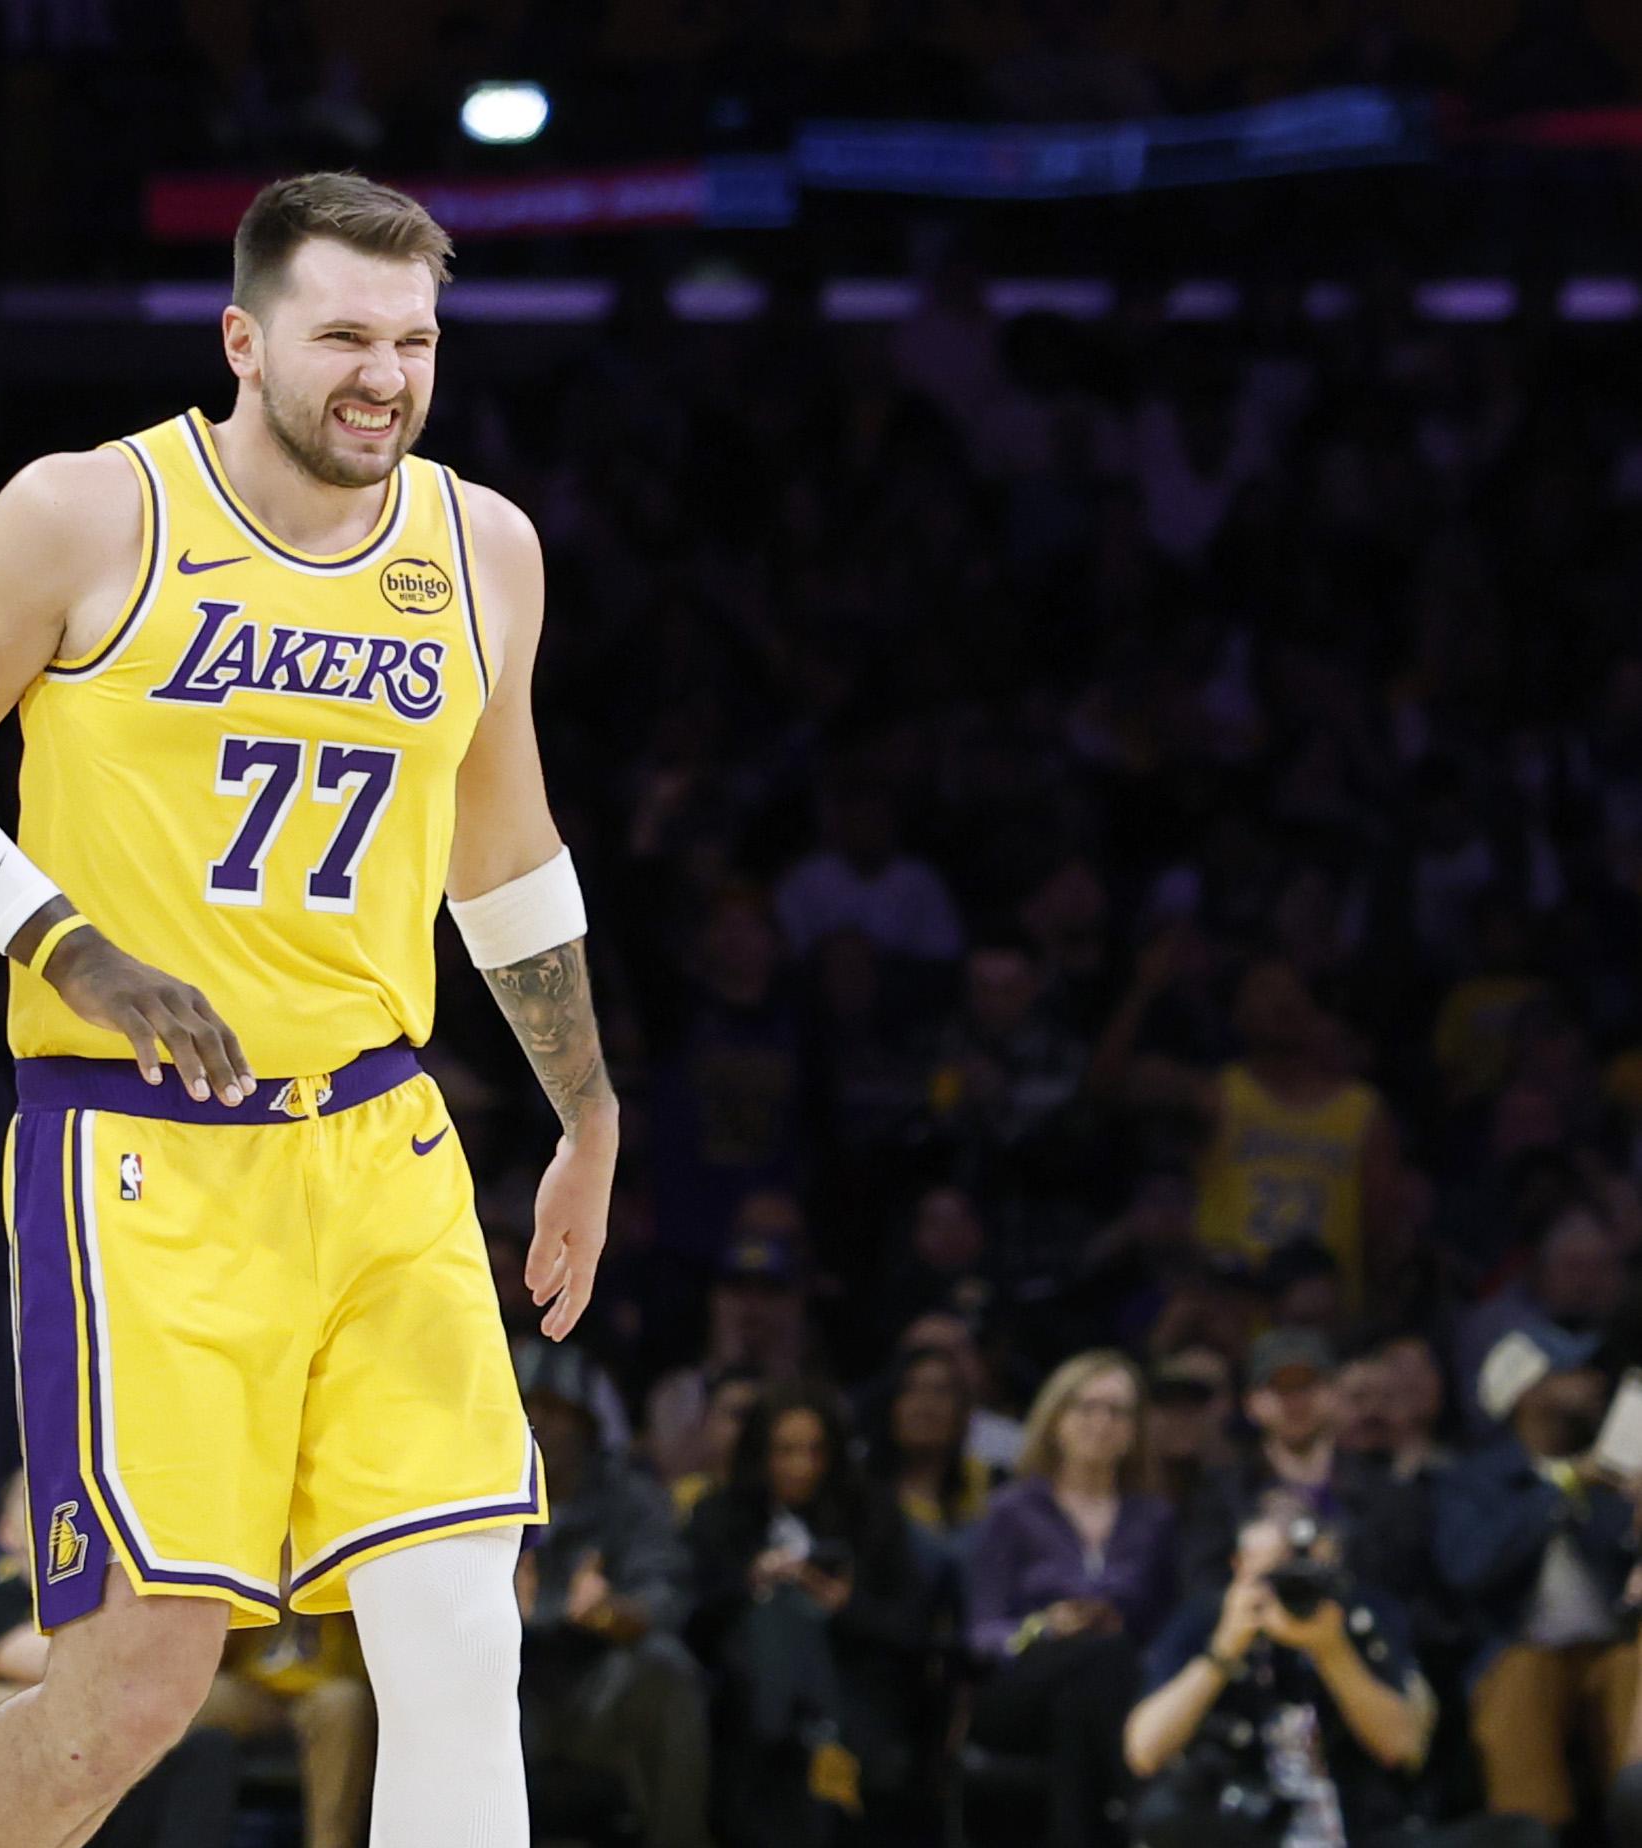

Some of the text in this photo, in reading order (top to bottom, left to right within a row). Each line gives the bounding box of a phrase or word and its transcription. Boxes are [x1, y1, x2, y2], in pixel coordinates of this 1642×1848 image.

[387, 572, 447, 599] bibigo
[148, 598, 447, 723] LAKERS
[204, 733, 403, 914] 77
